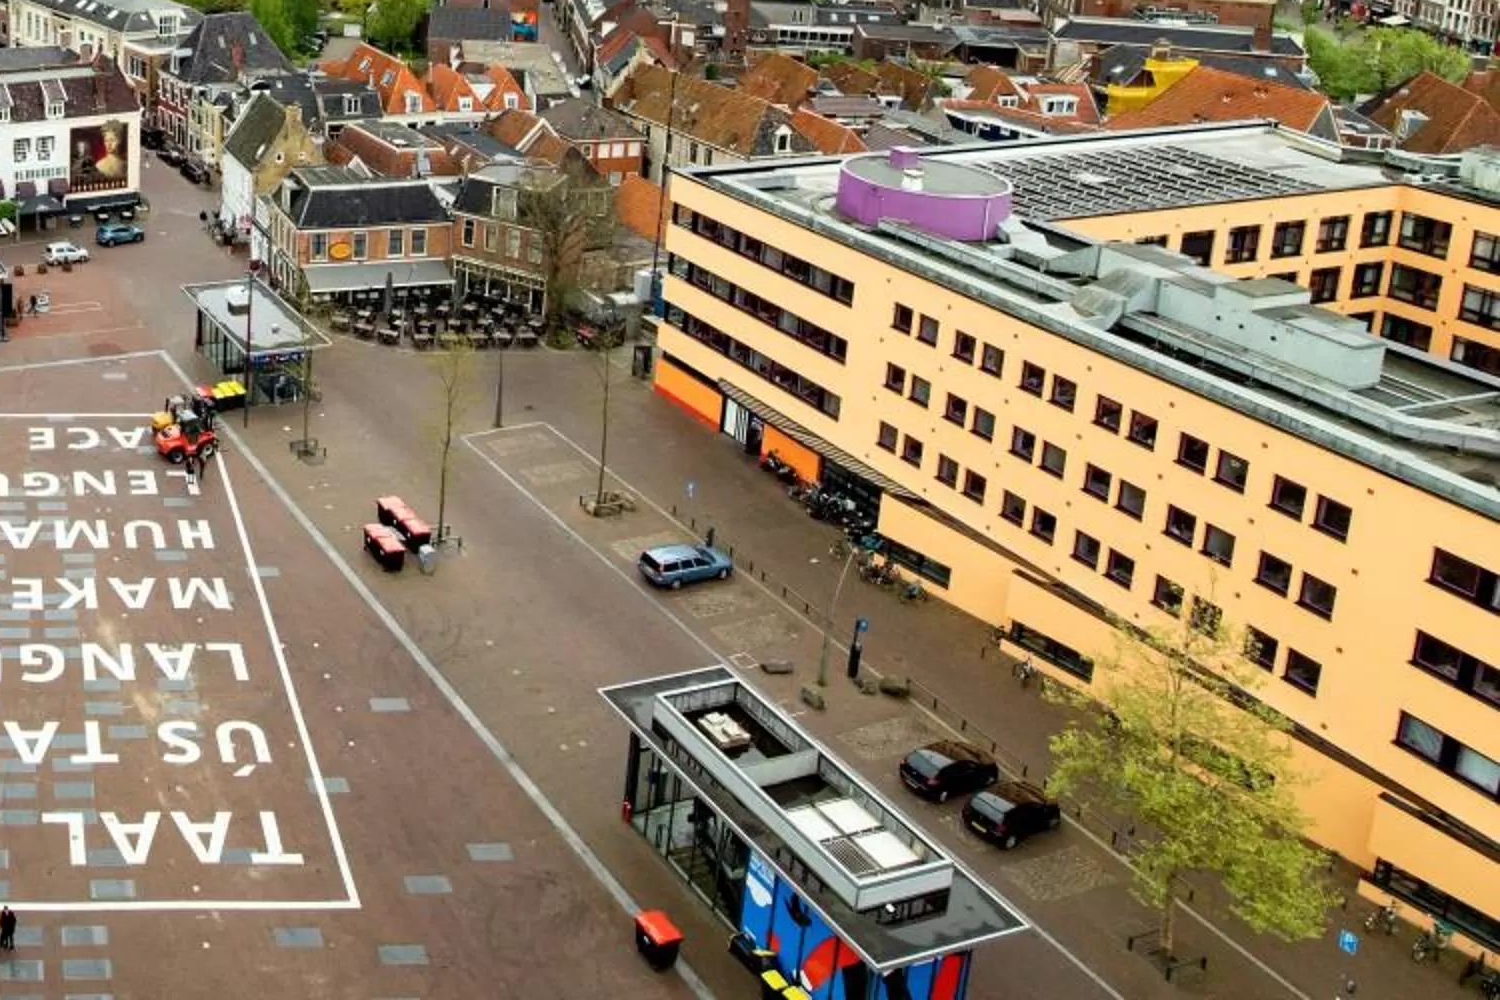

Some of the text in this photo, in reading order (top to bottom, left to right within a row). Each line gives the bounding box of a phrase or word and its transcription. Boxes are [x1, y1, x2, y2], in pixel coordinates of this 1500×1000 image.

[27, 426, 153, 452] ACE
[2, 720, 120, 765] TA
[156, 719, 273, 778] ÚS
[40, 810, 305, 866] TAAL
